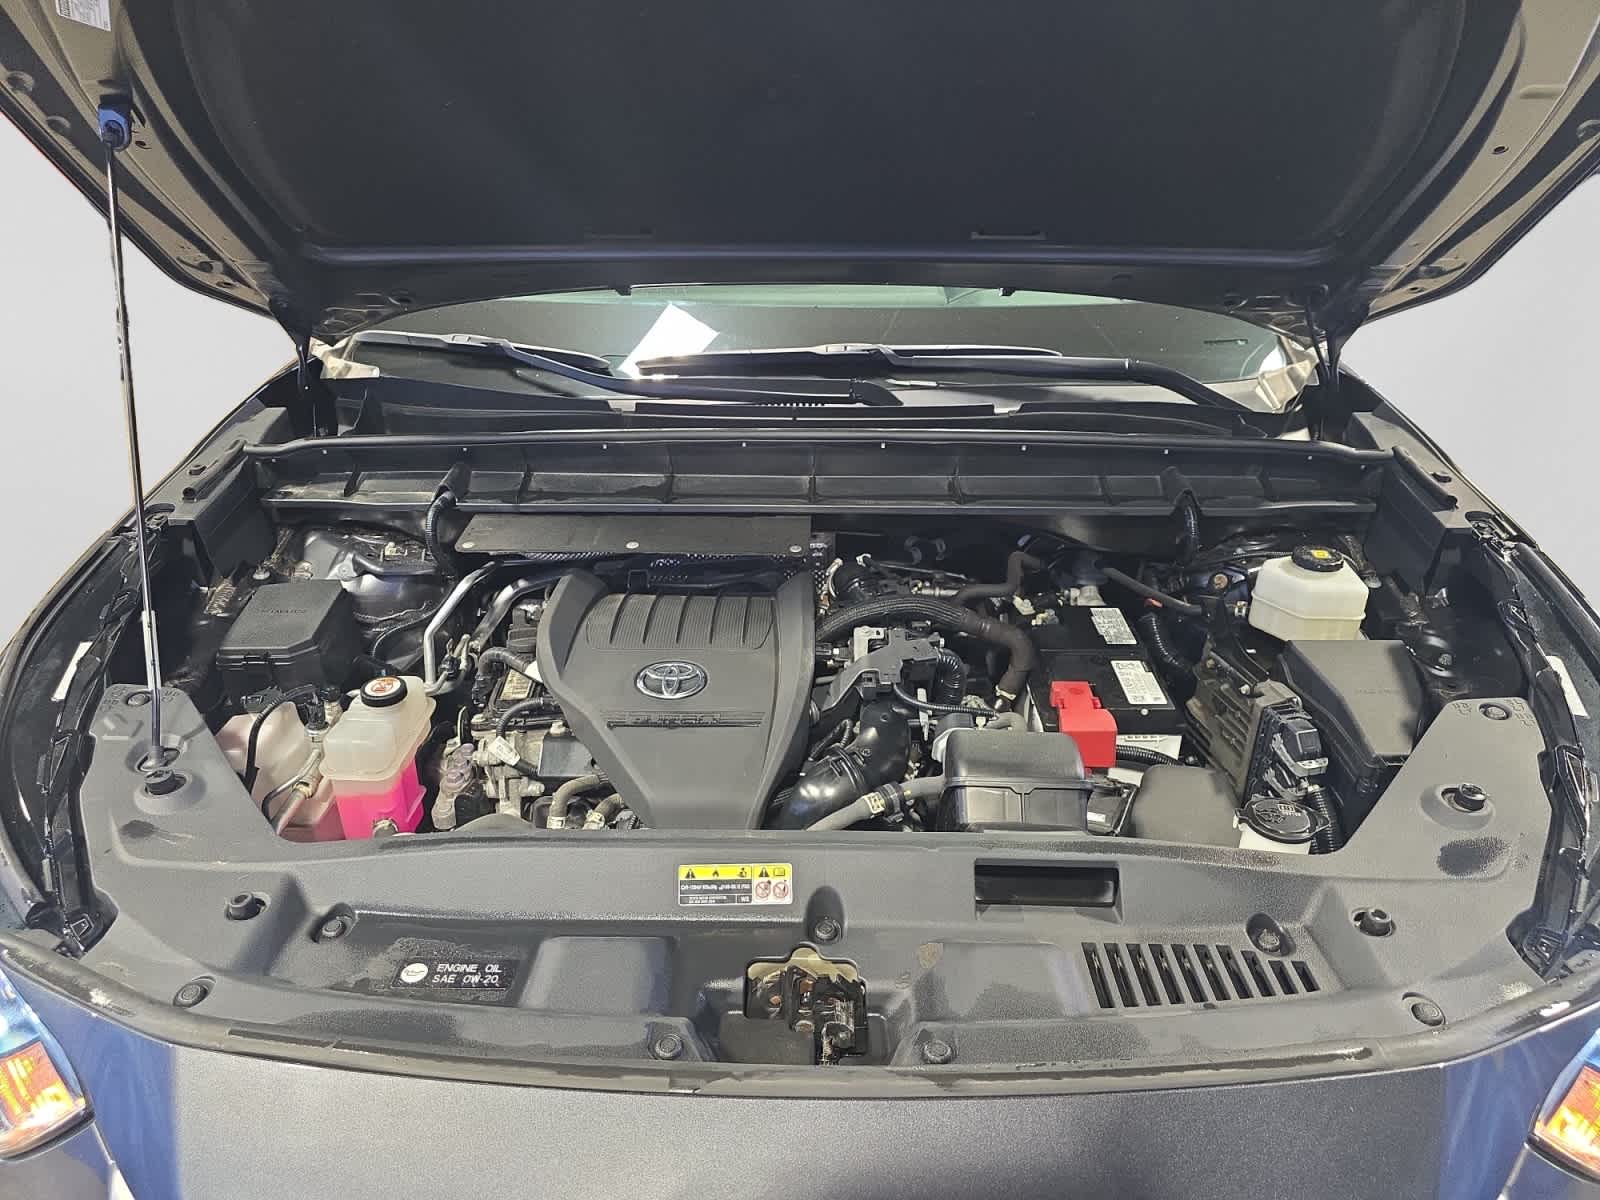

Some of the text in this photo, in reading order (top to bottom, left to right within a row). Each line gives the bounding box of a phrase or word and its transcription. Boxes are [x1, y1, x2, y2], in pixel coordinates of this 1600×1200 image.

[436, 963, 502, 973] ENGINE OIL
[432, 974, 499, 984] SAE 0W-20
